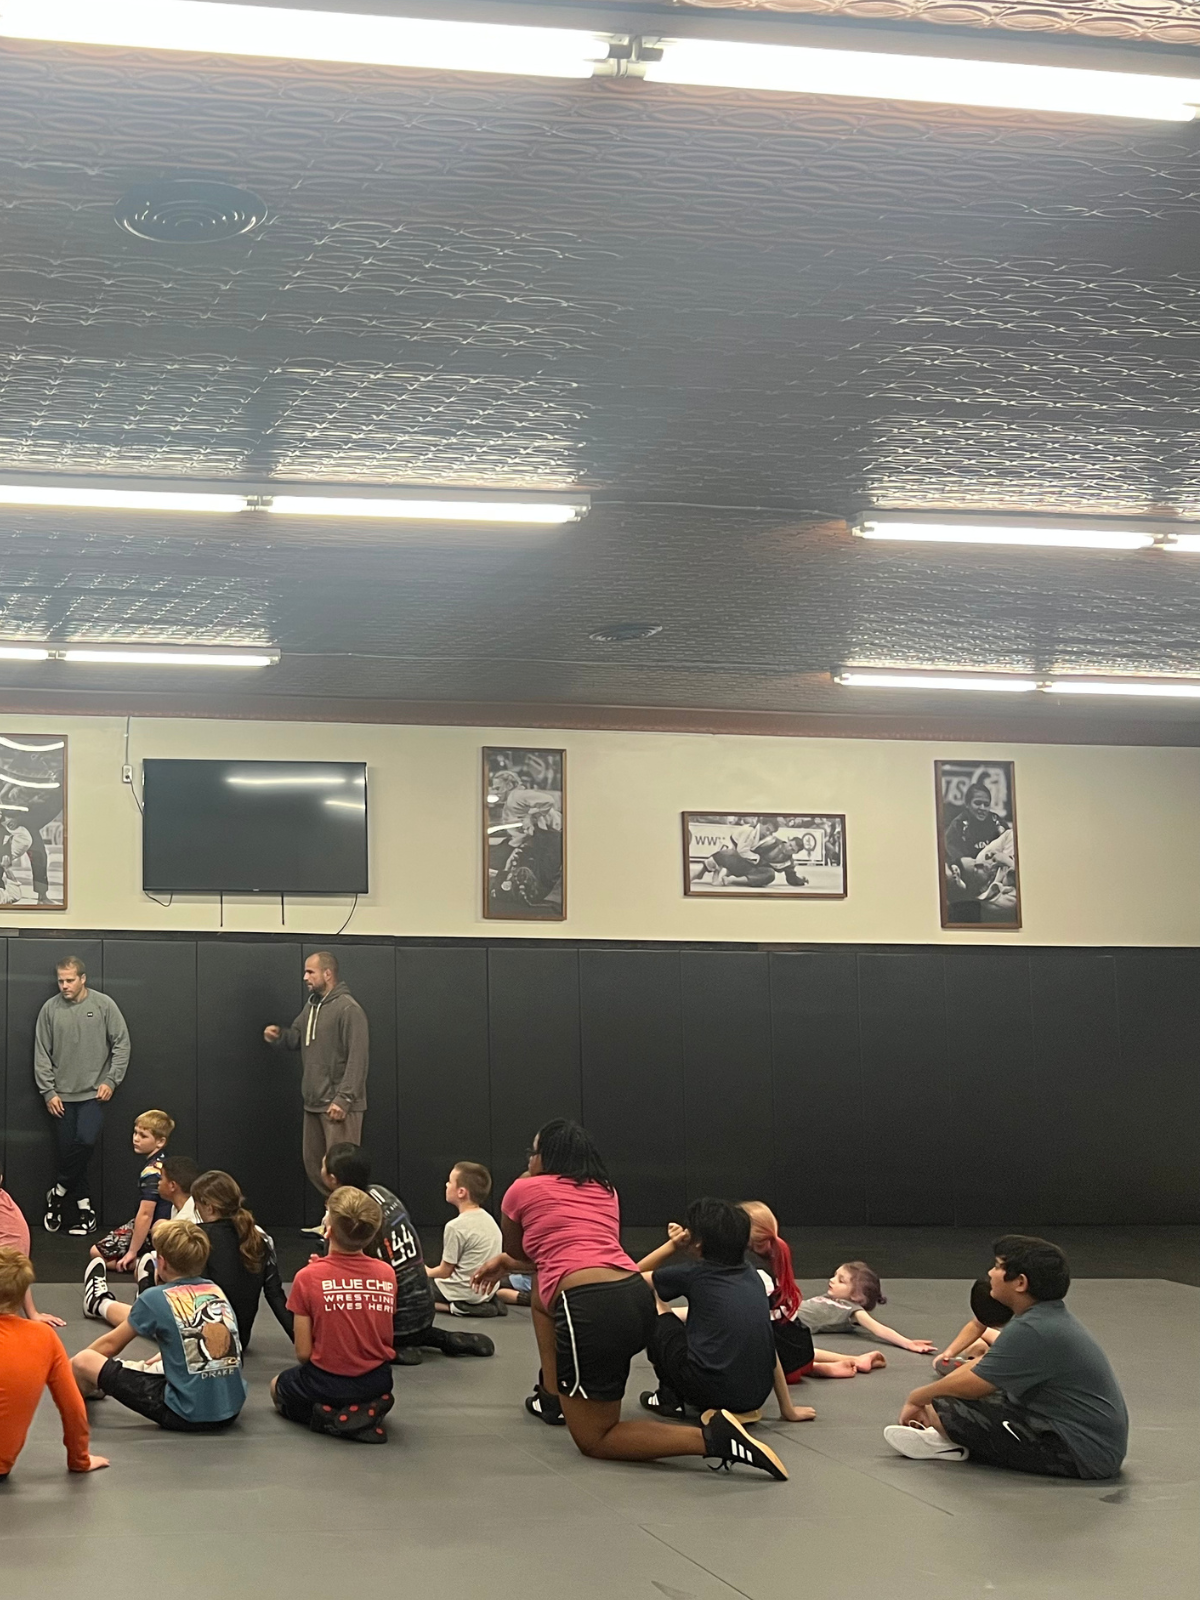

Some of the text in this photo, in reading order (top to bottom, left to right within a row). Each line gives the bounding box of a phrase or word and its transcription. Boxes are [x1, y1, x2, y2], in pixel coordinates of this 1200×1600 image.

[321, 1279, 394, 1292] BLUE CHIP
[323, 1294, 394, 1305] WRESTLIN
[325, 1303, 363, 1312] LIVES
[201, 1368, 235, 1380] DRAKE
